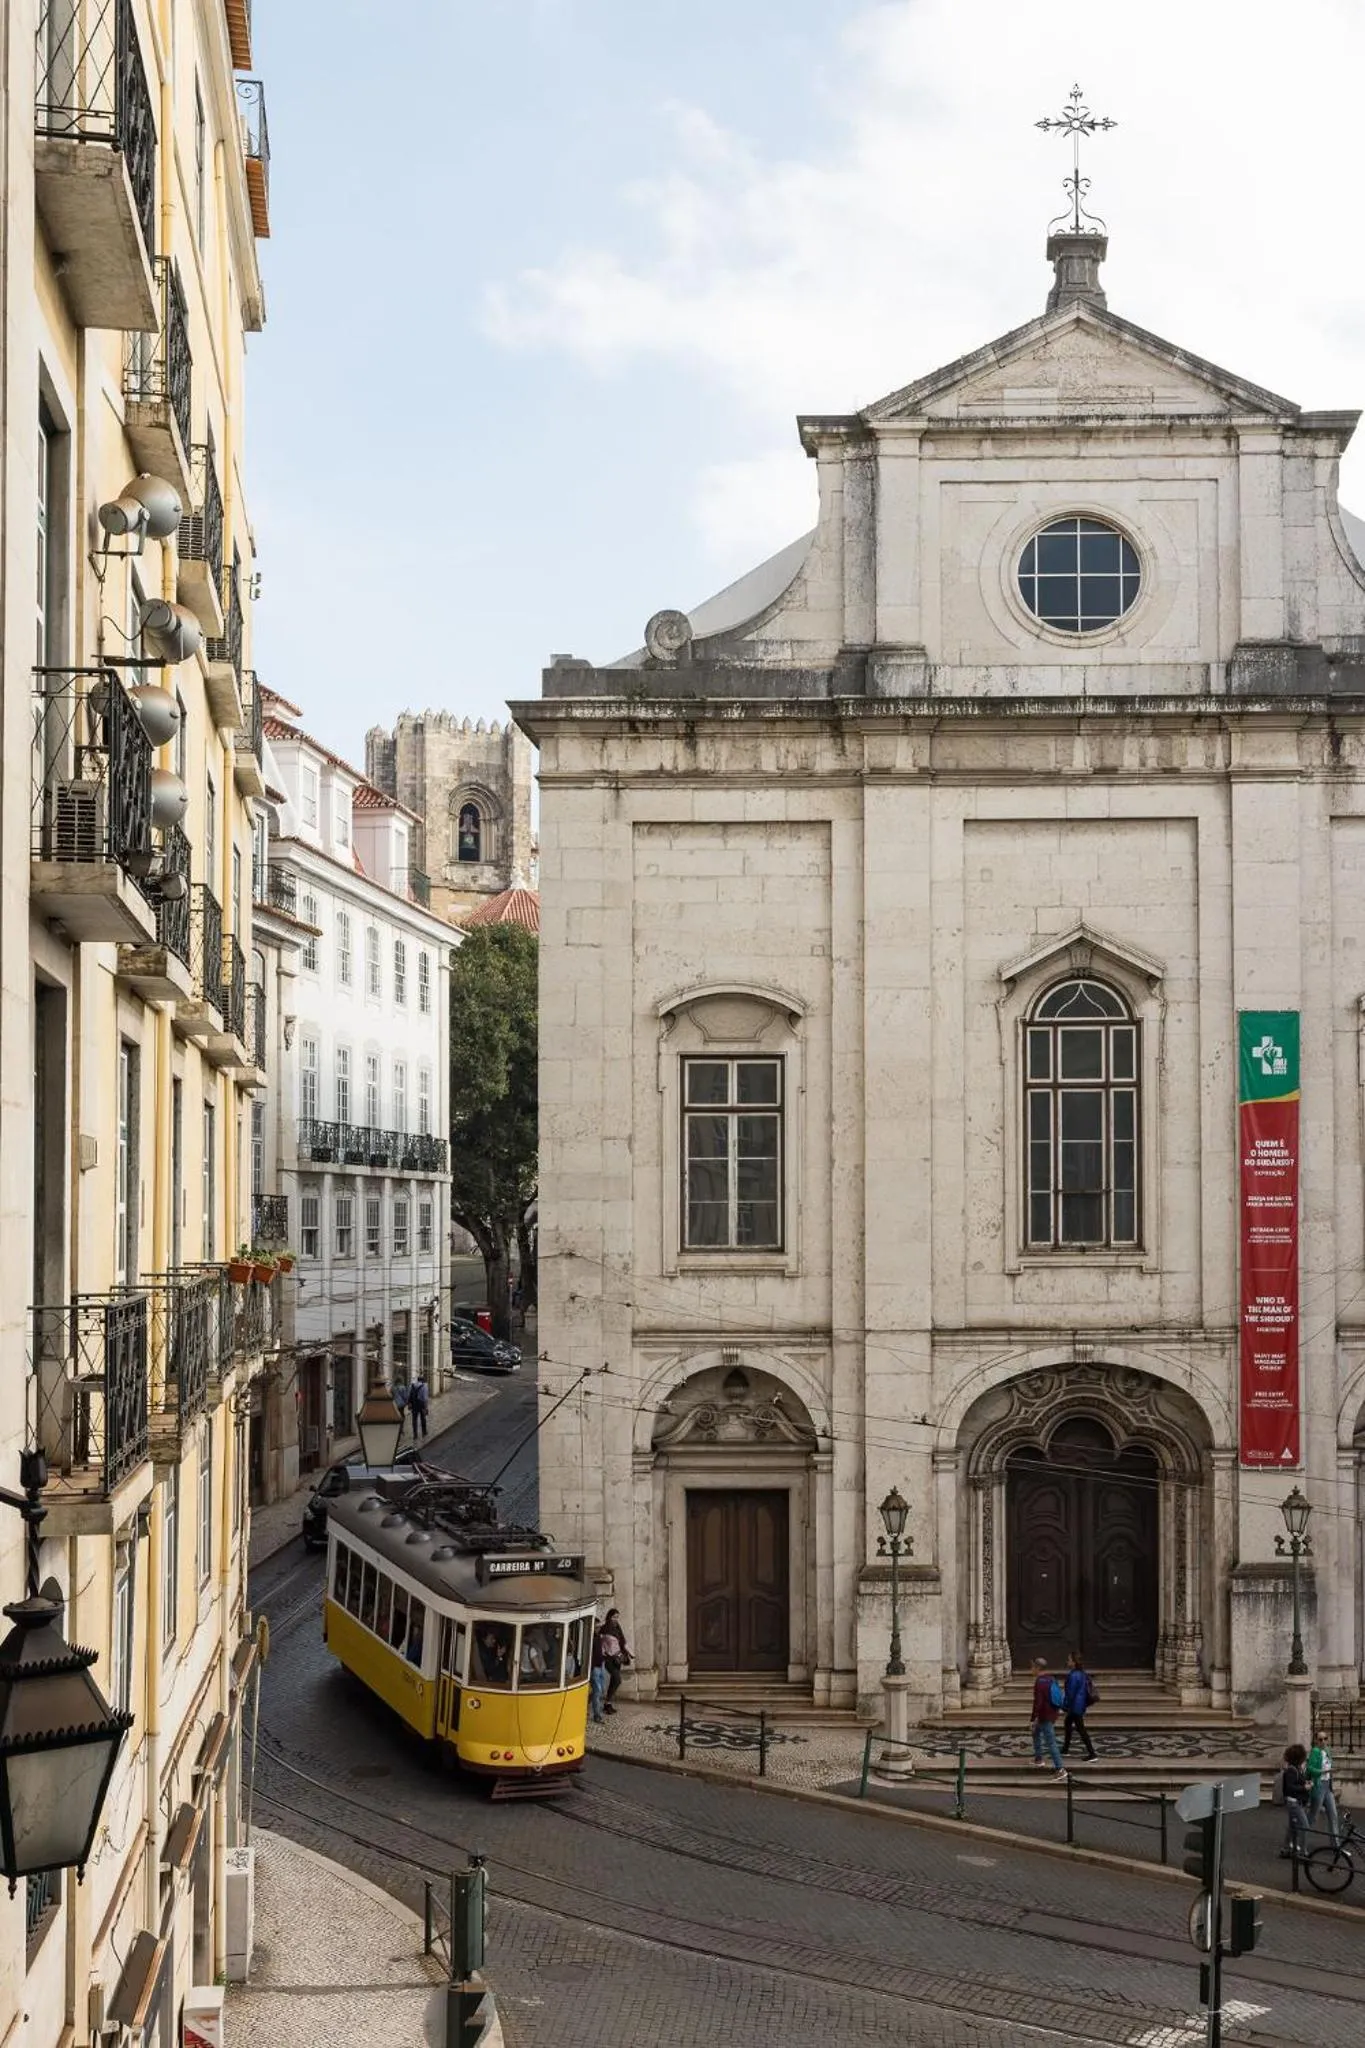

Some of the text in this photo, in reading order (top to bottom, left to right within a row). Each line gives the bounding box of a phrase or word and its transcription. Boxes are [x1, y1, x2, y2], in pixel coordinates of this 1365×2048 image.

[1255, 1138, 1285, 1149] QUEM É
[1250, 1149, 1289, 1157] O HOMEM
[1256, 1158, 1295, 1167] SUDÁRIO?
[1255, 1296, 1285, 1304] WHO IS
[1247, 1305, 1293, 1313] THE MAN OF
[1244, 1314, 1295, 1323] THE SHROUD?
[489, 1561, 530, 1573] CARREIRA
[557, 1558, 572, 1568] 28
